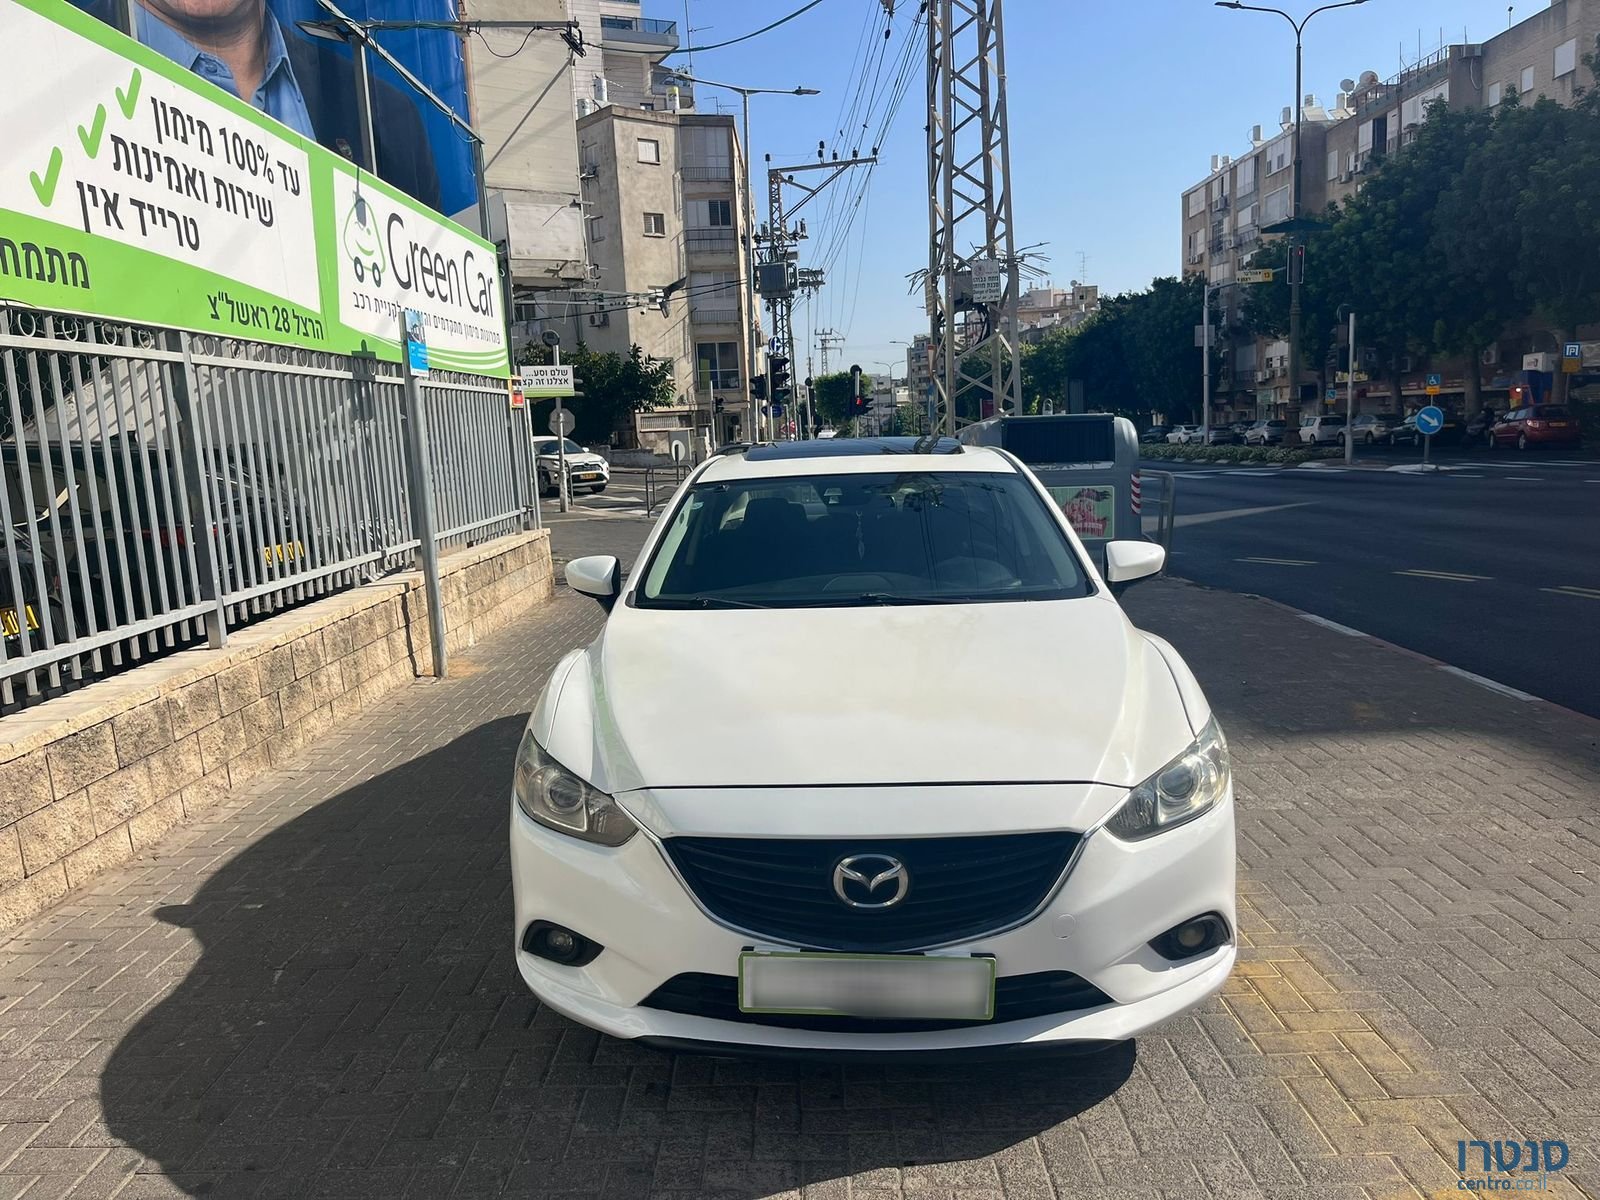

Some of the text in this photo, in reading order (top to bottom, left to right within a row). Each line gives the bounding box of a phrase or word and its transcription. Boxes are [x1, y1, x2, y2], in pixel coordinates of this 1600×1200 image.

[150, 96, 301, 197] עד 100% מימון
[110, 133, 274, 228] שירות ואמינות
[76, 180, 200, 251] טרייד אין
[387, 212, 494, 318] Green Car
[353, 291, 372, 312] רכב
[272, 305, 291, 334] 28
[292, 308, 324, 341] הרצל
[433, 315, 463, 336] מתקדמים
[546, 377, 569, 385] אצלנו
[550, 368, 569, 377] שלם
